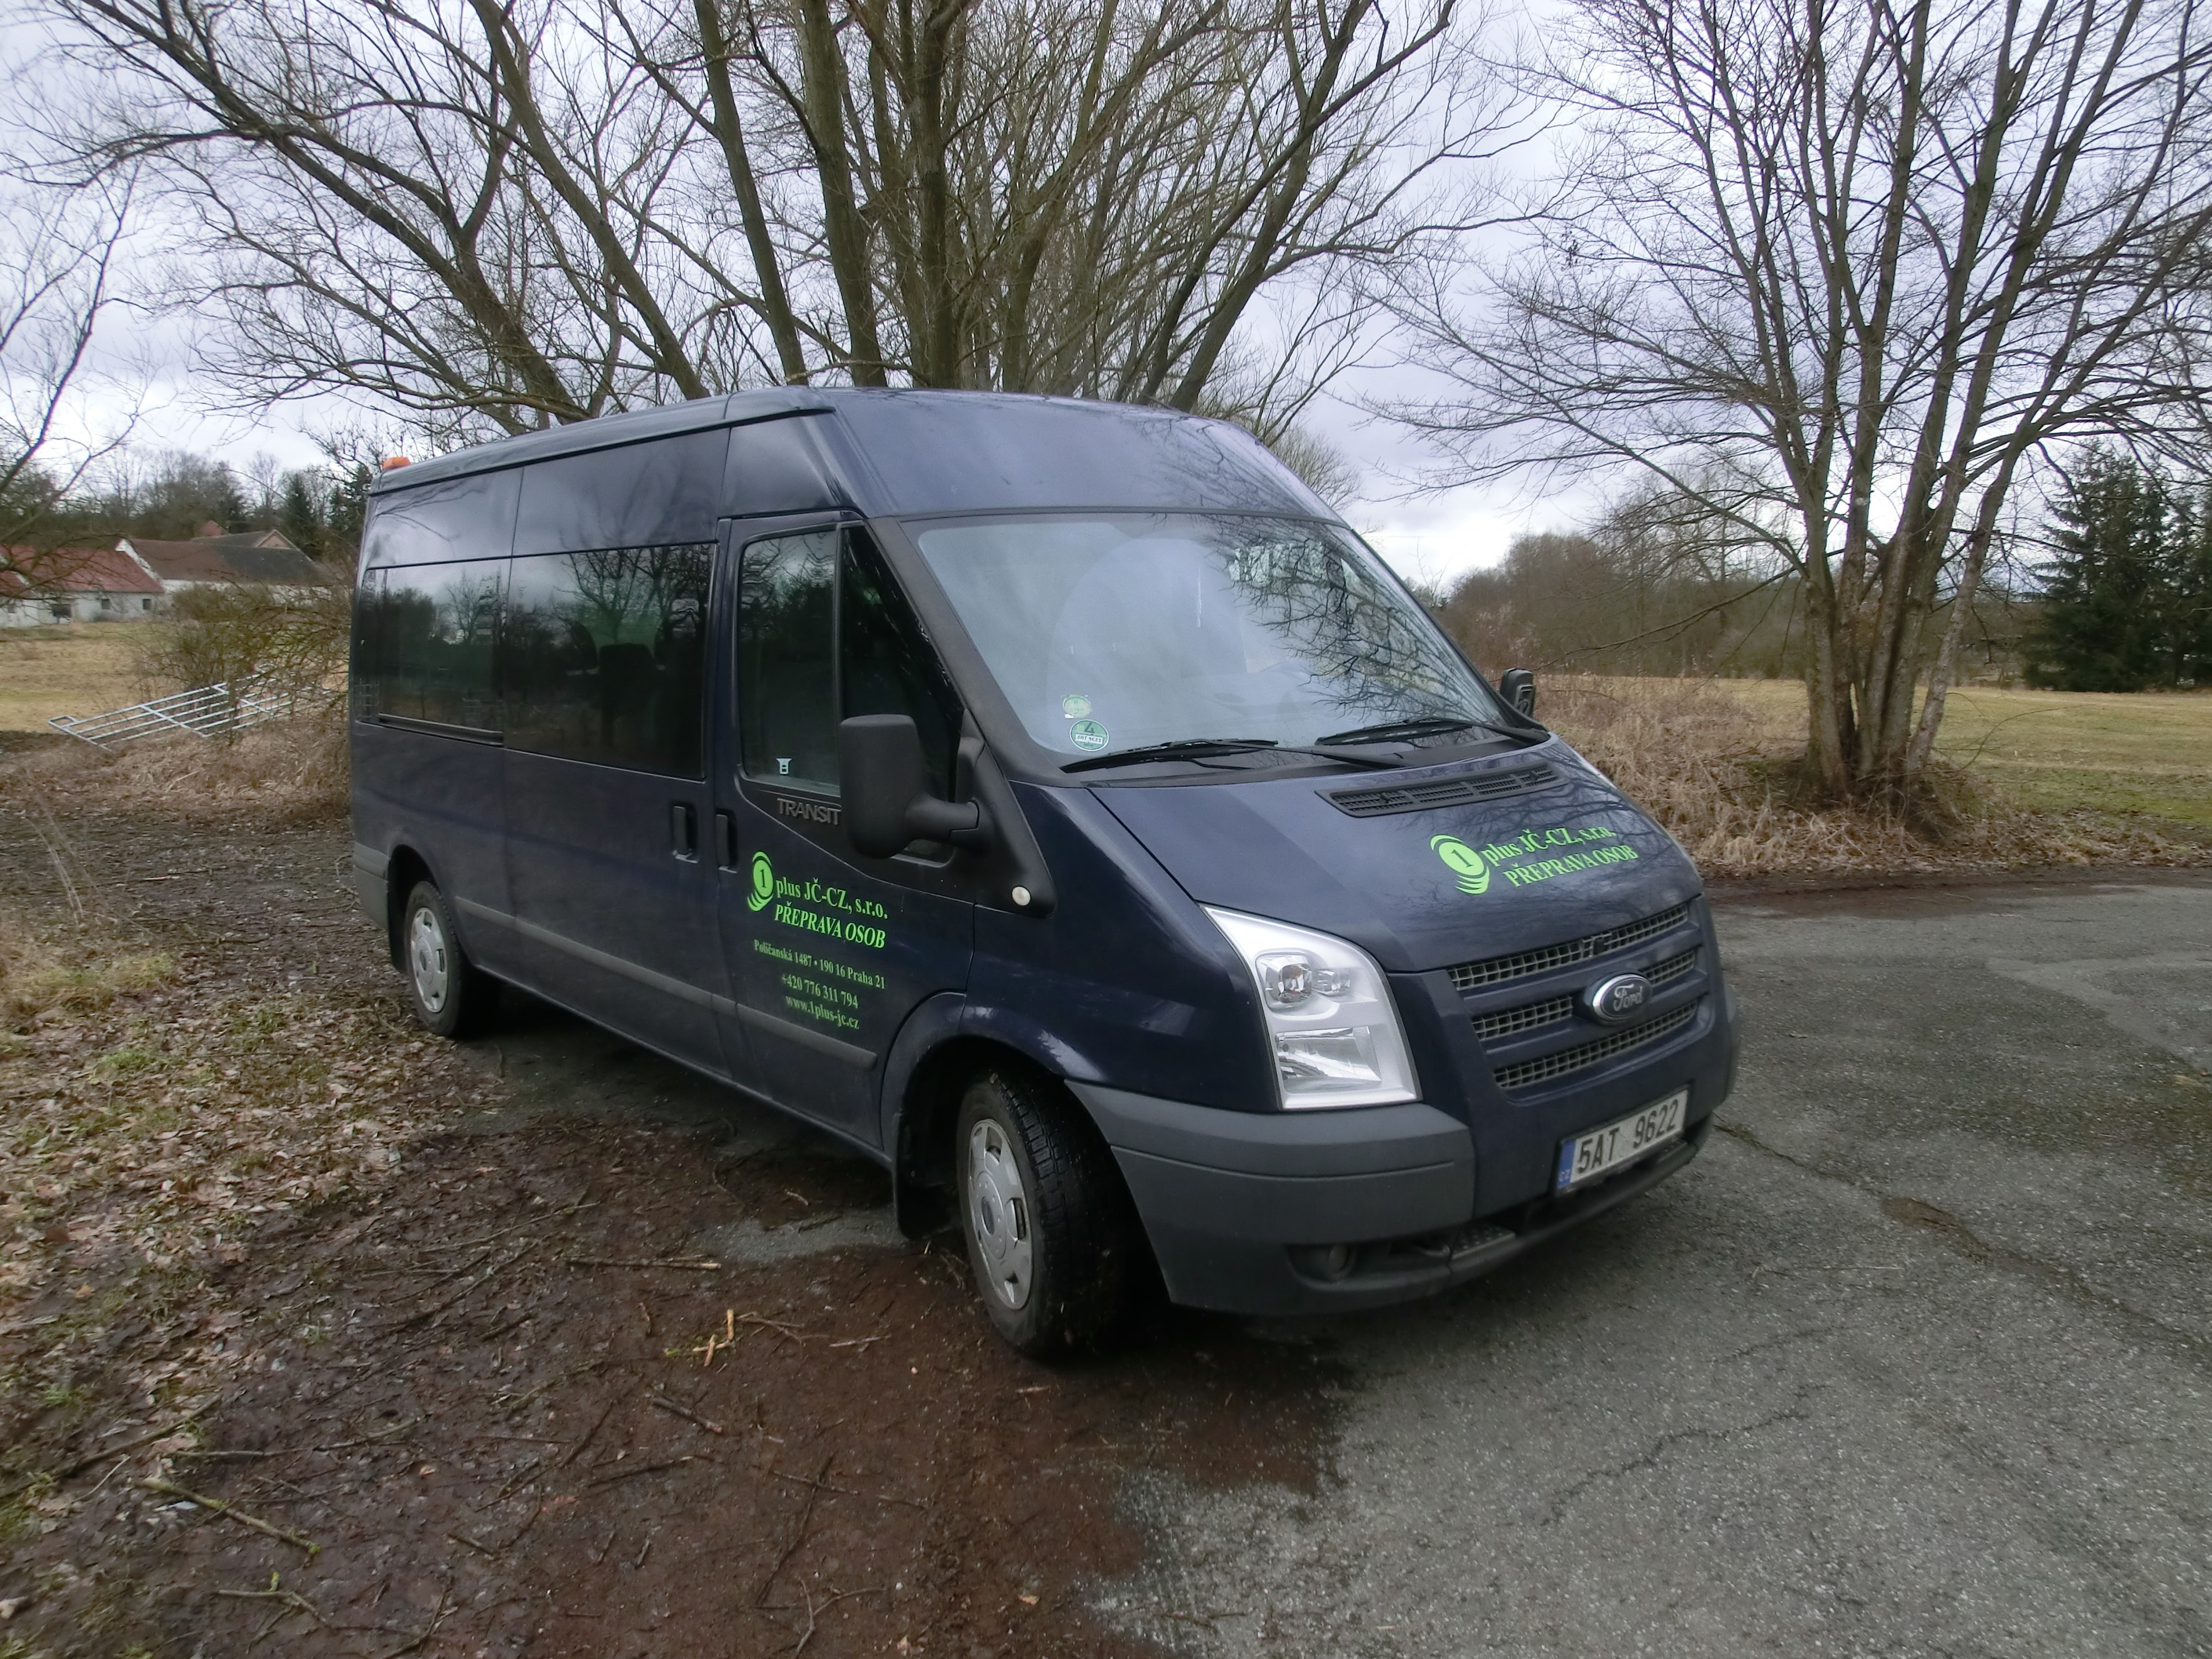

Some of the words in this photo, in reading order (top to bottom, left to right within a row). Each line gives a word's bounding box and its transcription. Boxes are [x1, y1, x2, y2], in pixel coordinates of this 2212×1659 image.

[777, 798, 842, 825] TRANSIT
[1450, 849, 1474, 868] 1
[1480, 843, 1522, 867] plus
[1517, 828, 1586, 852] JČ-CZ,
[1578, 826, 1616, 841] s.r.o.
[1502, 853, 1599, 887] PŘEPRAVA
[1592, 845, 1639, 864] OSOB
[760, 869, 767, 889] 1
[776, 877, 801, 899] plus
[804, 877, 853, 914] JČ-CZ,
[855, 899, 888, 919] s.r.o.
[774, 900, 842, 938] PŘEPRAVA
[846, 922, 886, 948] OSOB
[754, 939, 793, 961] Poličanská
[795, 952, 812, 967] 1487
[820, 959, 833, 974] 190
[836, 964, 846, 977] 16
[847, 966, 873, 985] Praha
[875, 974, 885, 989] 21
[781, 974, 803, 991] +420
[804, 979, 821, 997] 776
[822, 985, 839, 1003] 311
[841, 990, 858, 1009] 794
[785, 995, 859, 1030] www.1plus-jc.cz
[1613, 983, 1643, 1011] Ford
[1578, 1127, 1620, 1173] 5AT
[1633, 1099, 1678, 1148] 9622
